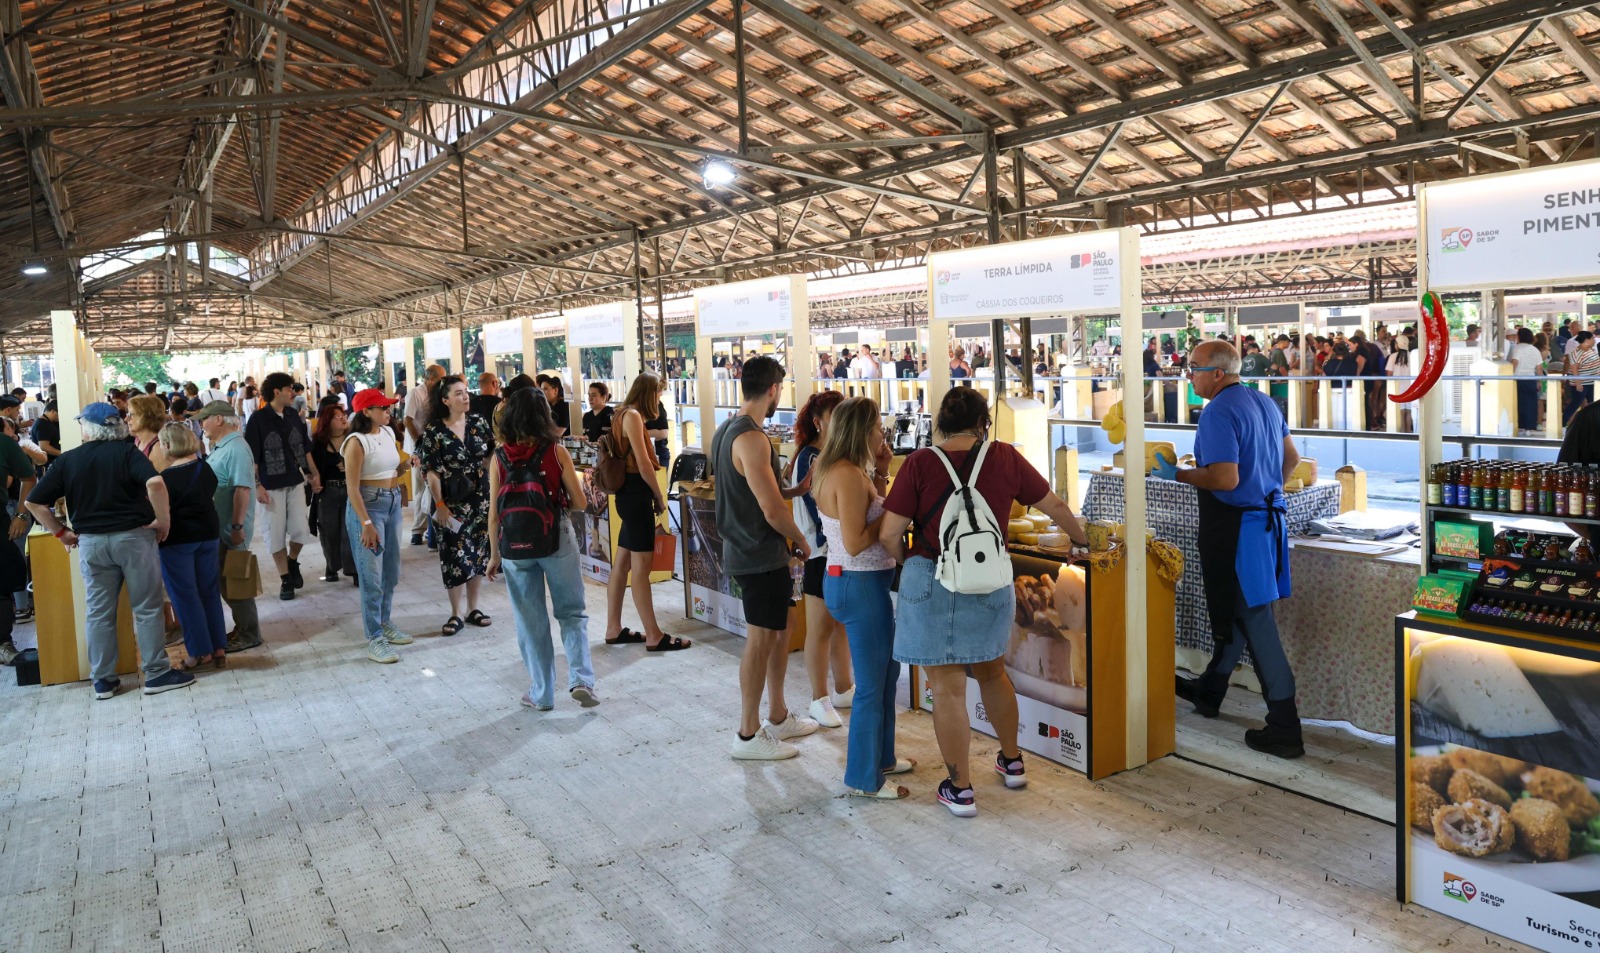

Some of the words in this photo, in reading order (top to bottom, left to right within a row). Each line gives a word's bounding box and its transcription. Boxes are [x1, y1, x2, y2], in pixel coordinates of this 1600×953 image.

[1544, 188, 1600, 209] SENH
[1524, 212, 1600, 234] PIMENT
[1093, 250, 1106, 259] SÃO
[984, 267, 1012, 278] TERRA
[1015, 262, 1052, 275] LÍMPIDA
[976, 299, 1000, 308] CÁSSIA
[1002, 298, 1018, 307] DOS
[1019, 295, 1064, 306] COQUEIROS
[1061, 729, 1074, 740] SÃO
[1061, 737, 1081, 750] PAULO
[1481, 892, 1504, 904] SABOR
[1526, 917, 1579, 943] Turismo
